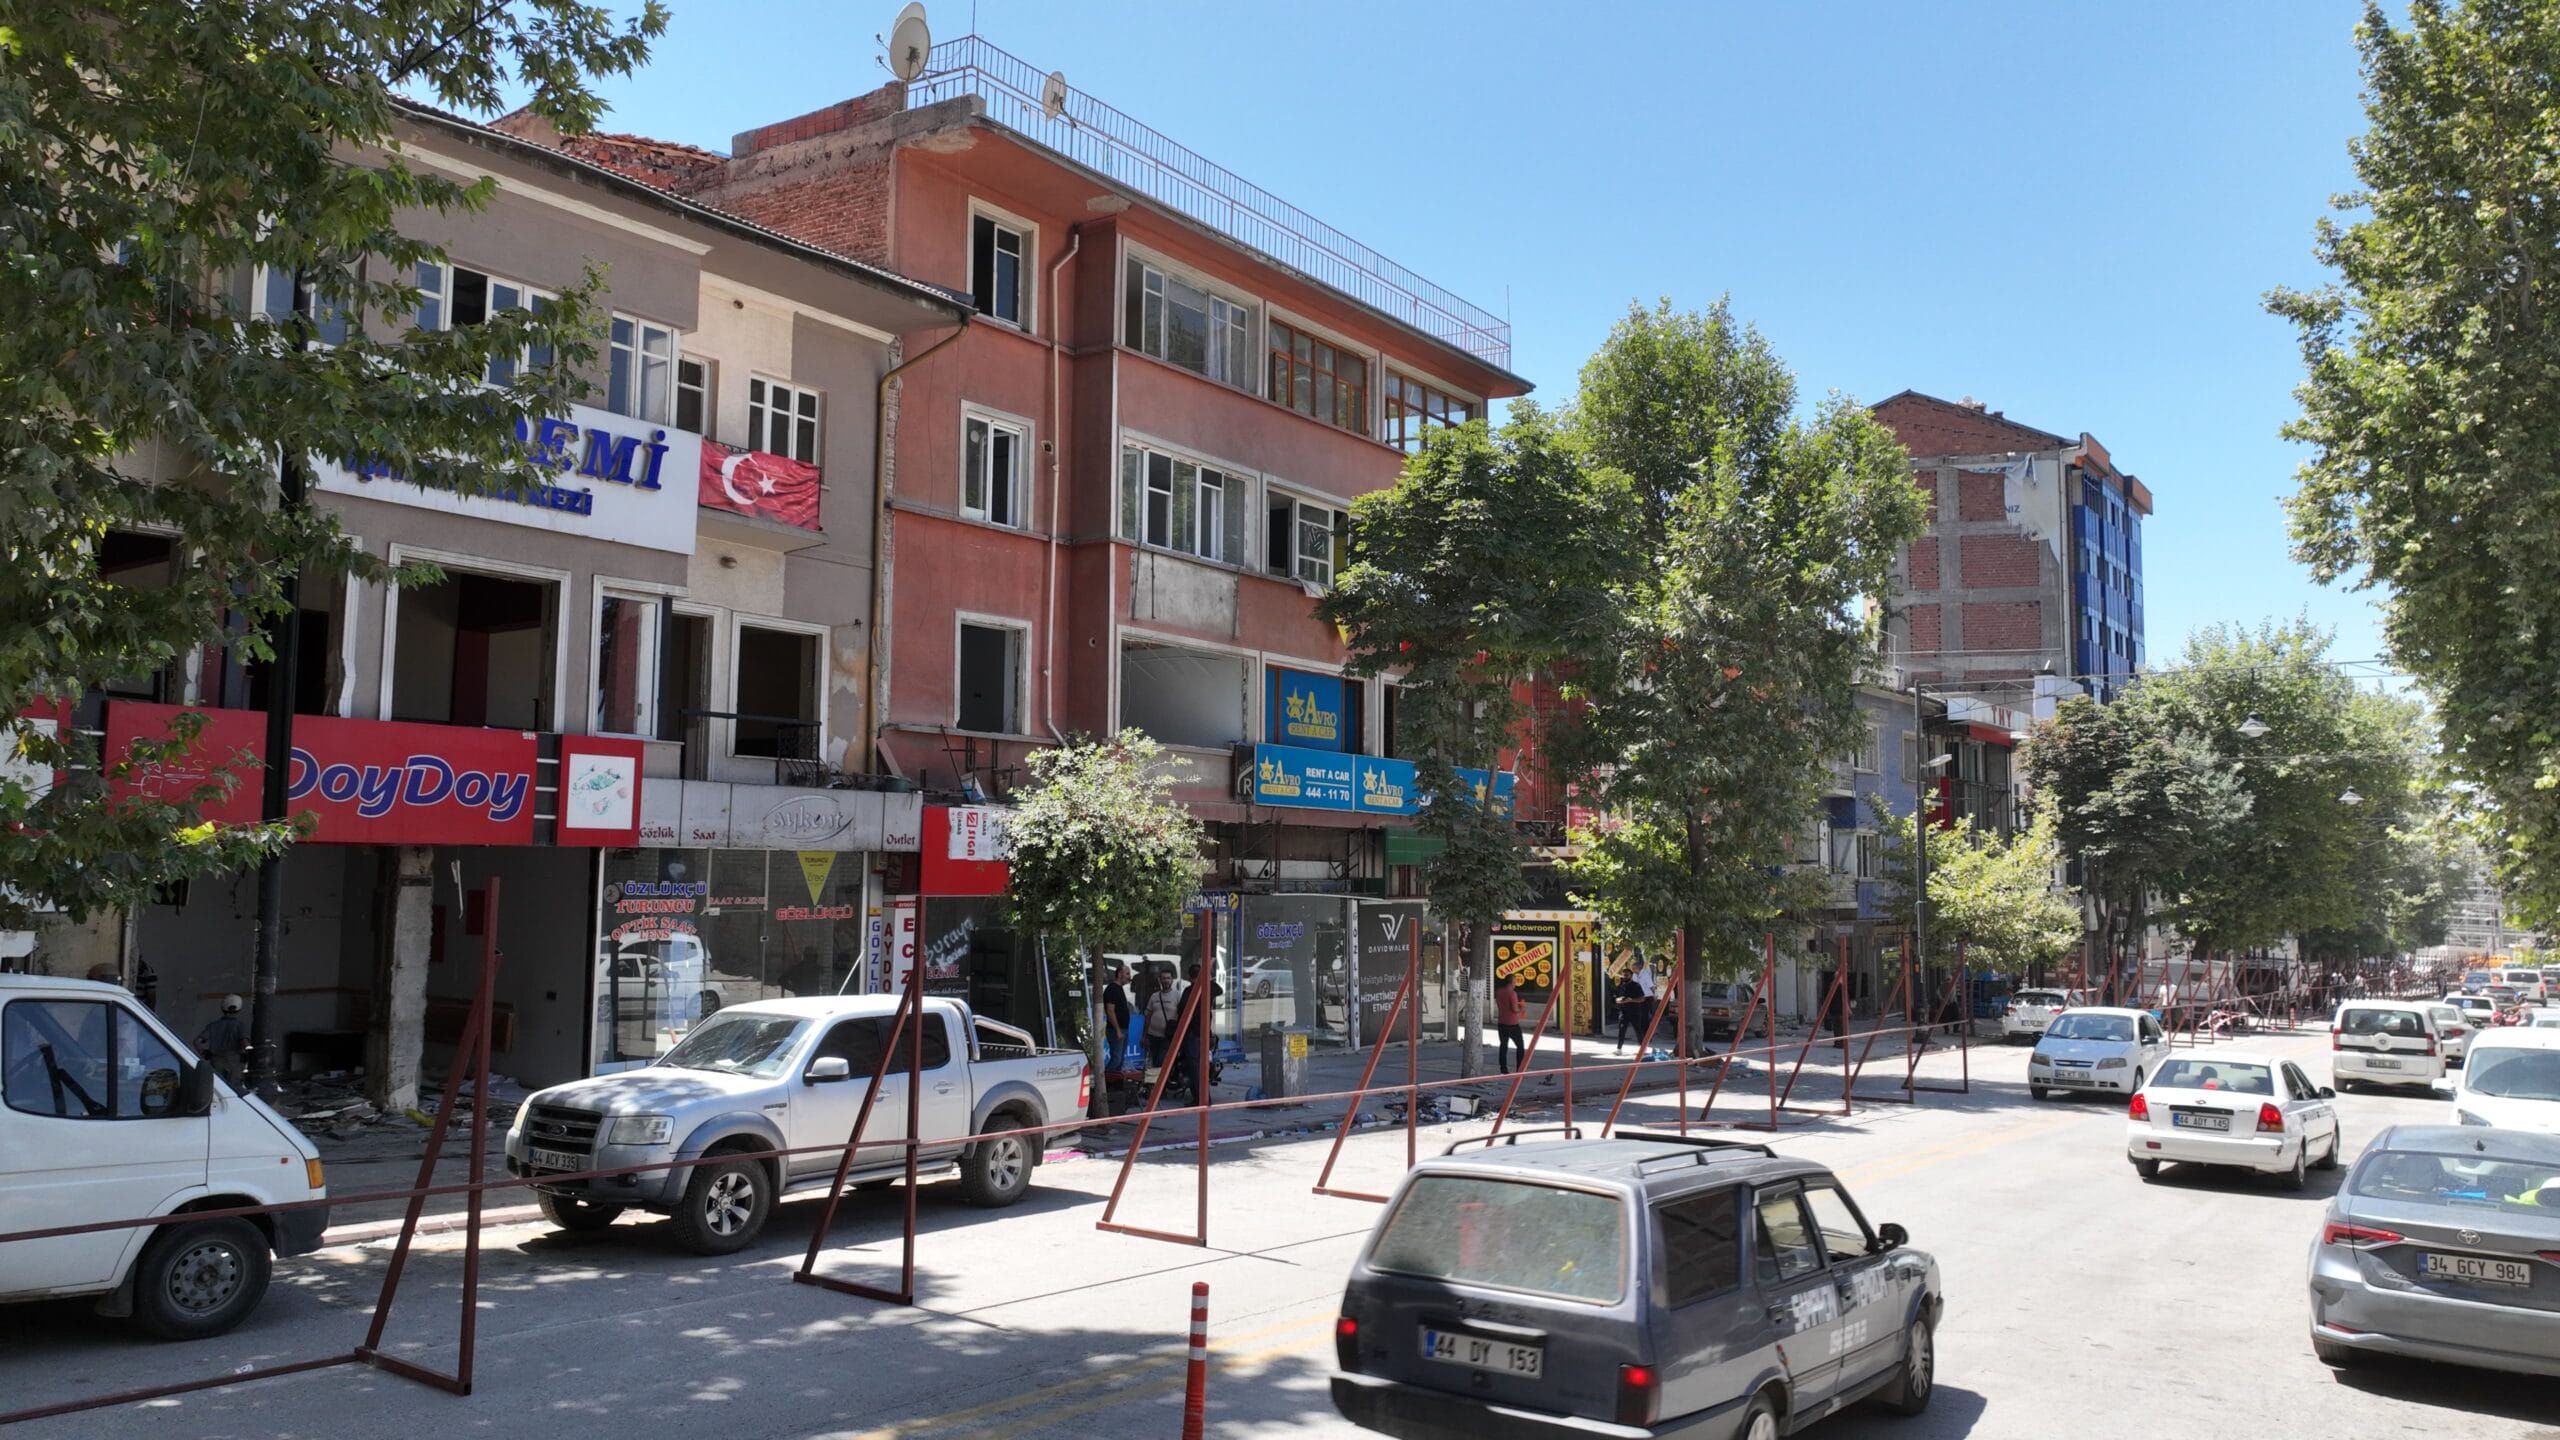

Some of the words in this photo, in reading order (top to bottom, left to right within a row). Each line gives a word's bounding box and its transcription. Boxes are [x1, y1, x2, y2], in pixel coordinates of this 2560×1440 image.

[1274, 759, 1301, 786] AVRO
[1306, 767, 1326, 779] RENT
[1327, 769, 1334, 780] A
[1334, 770, 1350, 781] CAR
[1377, 769, 1404, 797] AVRO
[1306, 786, 1321, 799] 444
[1328, 788, 1338, 800] 11
[1340, 789, 1350, 801] 70
[639, 826, 674, 839] Gözlük
[692, 829, 716, 841] Saat
[886, 834, 915, 846] Outlet
[616, 881, 708, 898] ÖZLÜKÇÜ
[616, 899, 696, 914] TURUNCU
[611, 915, 658, 941] OPTİK
[660, 915, 697, 937] SAAT
[640, 928, 671, 940] LENS
[2178, 1114, 2189, 1124] 44
[2213, 1118, 2227, 1129] 145
[532, 1152, 542, 1164] 44
[546, 1153, 560, 1166] ACV
[561, 1155, 576, 1168] 335
[2429, 1256, 2448, 1272] 34
[2457, 1259, 2486, 1277] GCY
[2496, 1263, 2526, 1281] 984
[1436, 1335, 1455, 1359] 44
[1470, 1341, 1492, 1364] DY
[1507, 1347, 1538, 1373] 153
